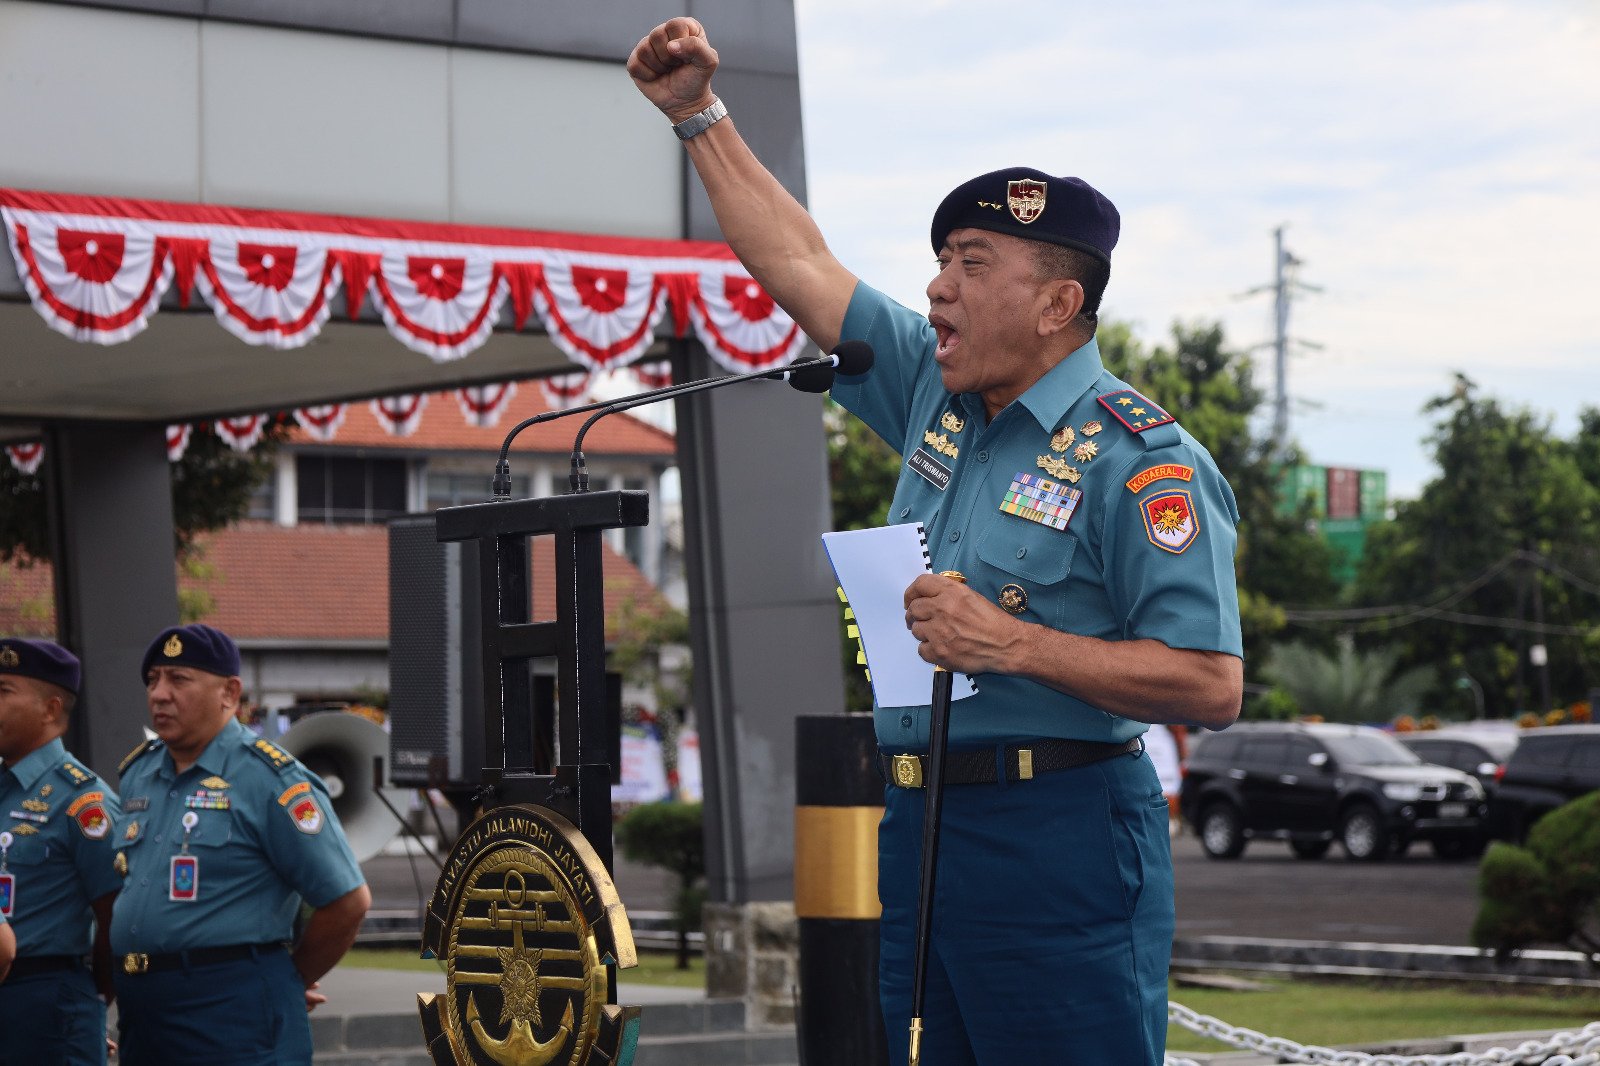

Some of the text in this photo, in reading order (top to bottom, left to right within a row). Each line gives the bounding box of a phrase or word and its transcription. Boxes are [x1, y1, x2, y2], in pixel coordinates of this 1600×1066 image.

[911, 454, 949, 483] ALI TRISWANTO
[1131, 466, 1190, 490] KODAERAL V
[485, 817, 553, 848] JALANIDHI
[554, 845, 594, 906] JAYATI
